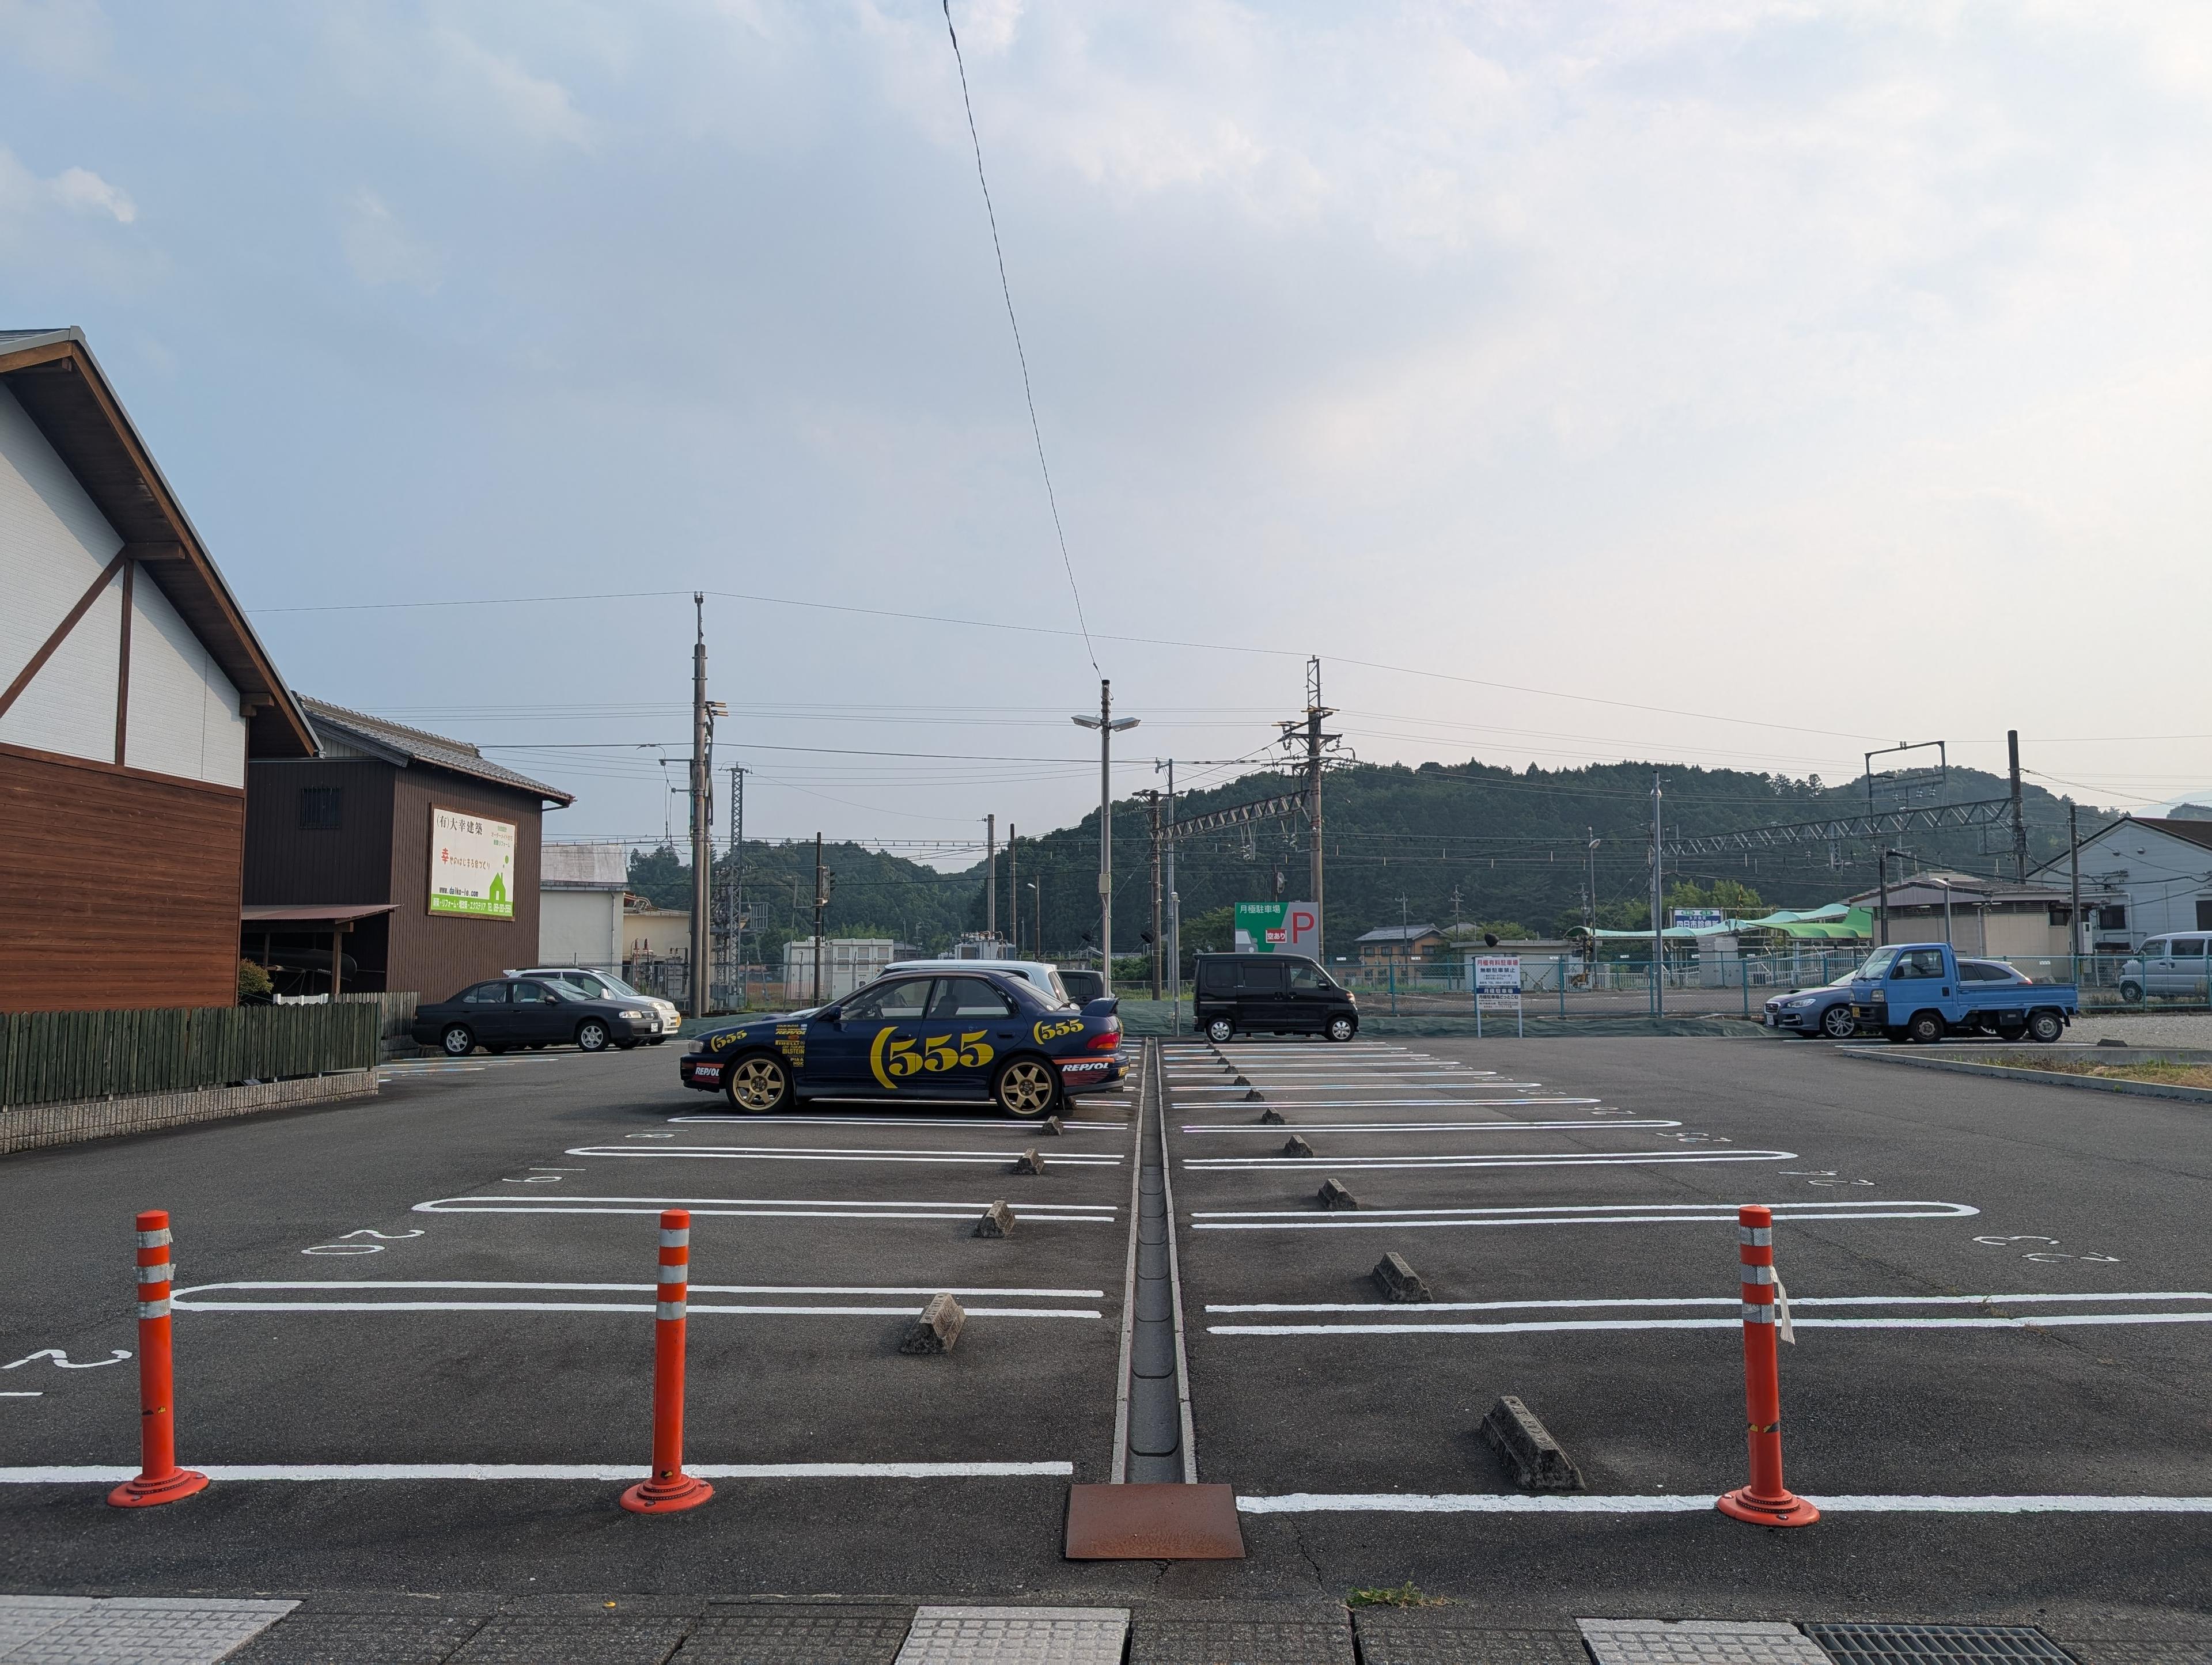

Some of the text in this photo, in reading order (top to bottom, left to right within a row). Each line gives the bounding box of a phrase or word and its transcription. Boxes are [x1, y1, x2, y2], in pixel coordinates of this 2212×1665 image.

[437, 815, 483, 835] (有)大幸建築
[441, 848, 490, 870] 幸せのはじまる家づくり
[439, 886, 479, 897] www.daiko-ie.com
[1240, 904, 1281, 914] 月極駐車場
[1292, 912, 1315, 944] P
[1267, 932, 1285, 940] 空あり
[695, 1067, 720, 1076] REPSOL
[1062, 1062, 1109, 1072] REPSOL
